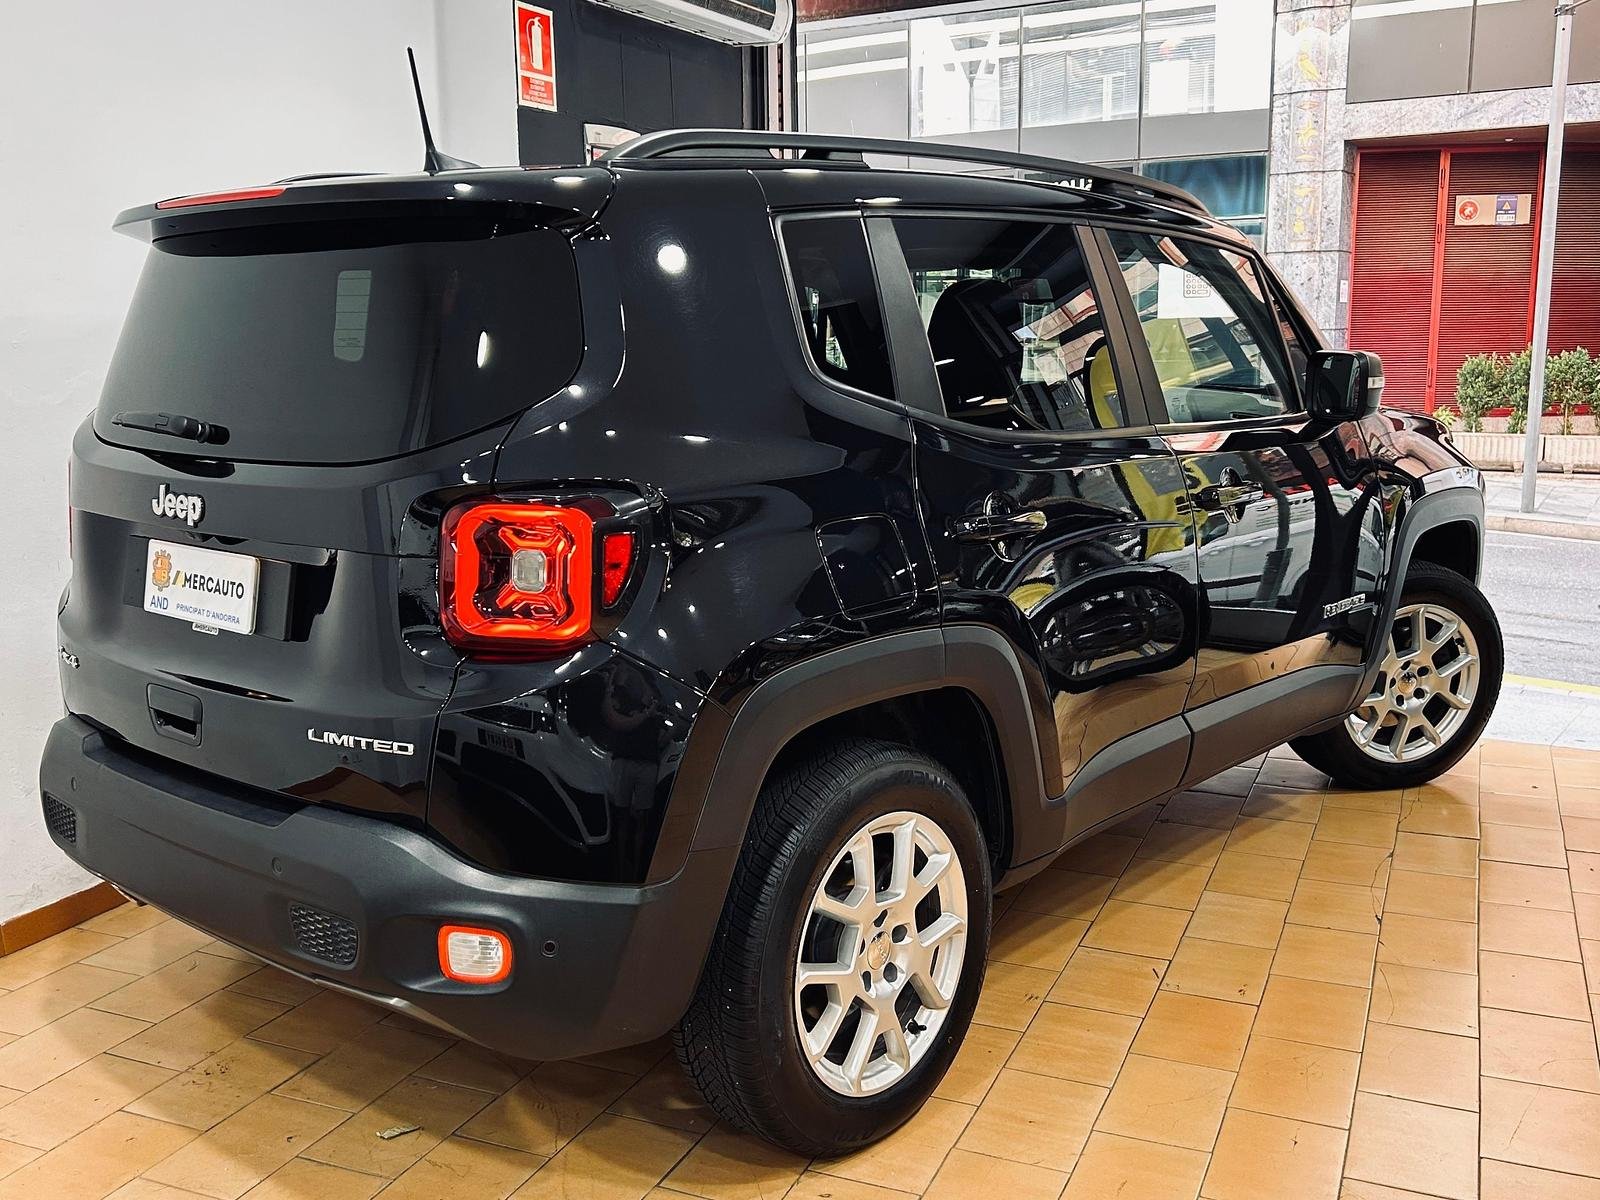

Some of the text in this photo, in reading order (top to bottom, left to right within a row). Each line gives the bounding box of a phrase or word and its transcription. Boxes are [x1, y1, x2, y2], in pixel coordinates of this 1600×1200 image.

[151, 484, 203, 527] Jeep
[182, 571, 245, 600] MERCAUTO
[149, 595, 169, 610] AND
[175, 602, 205, 617] PRINCIPAT
[307, 727, 415, 757] LIMITED
